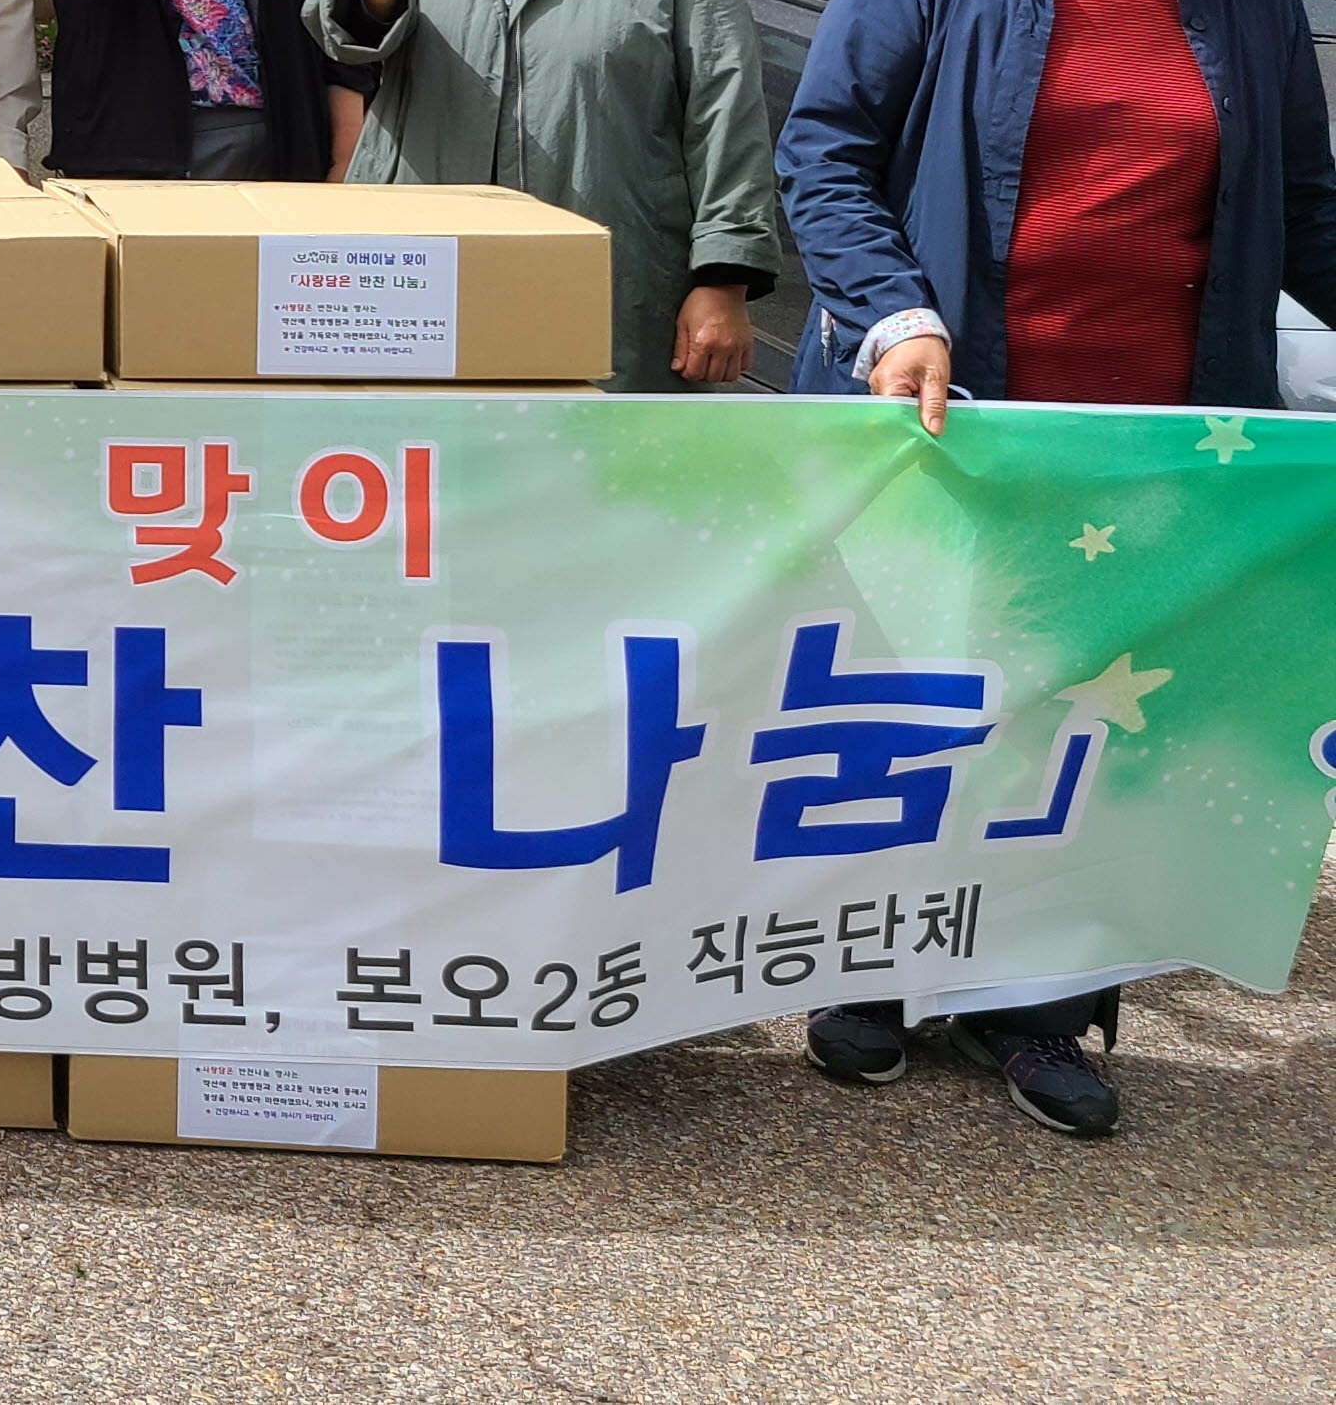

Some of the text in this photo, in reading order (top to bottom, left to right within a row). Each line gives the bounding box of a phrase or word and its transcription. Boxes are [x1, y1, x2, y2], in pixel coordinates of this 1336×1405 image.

[346, 253, 395, 266] 어버이날
[402, 253, 427, 266] 맞이
[359, 276, 385, 288] 반찬
[393, 276, 427, 289] 나눔」
[106, 443, 431, 586] 맞이
[437, 622, 1092, 895] 나눔」
[335, 939, 648, 1033] 본오2동
[685, 883, 982, 995] 직능단체
